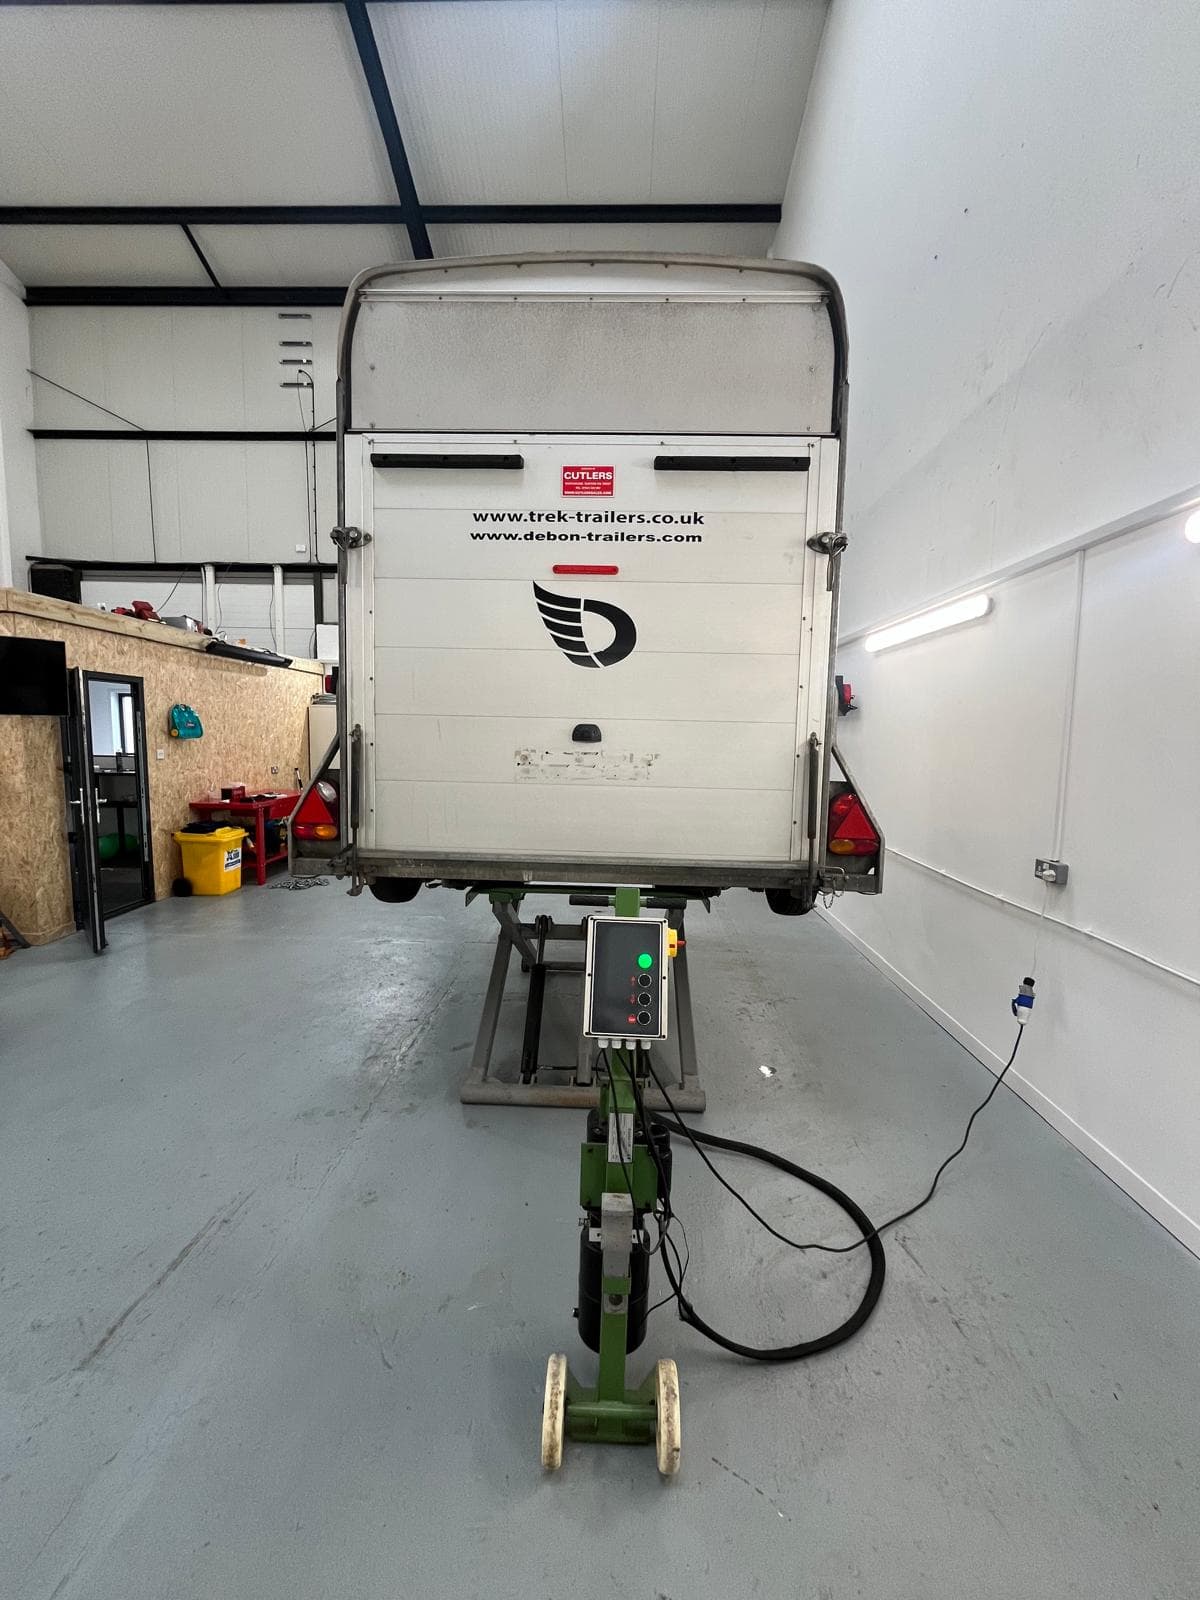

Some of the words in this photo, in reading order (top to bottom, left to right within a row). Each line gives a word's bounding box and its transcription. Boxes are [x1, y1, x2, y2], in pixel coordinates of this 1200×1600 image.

[563, 471, 613, 480] CUTLERS
[472, 510, 705, 525] www.trek-trailers.co.uk
[470, 531, 703, 543] www.debon-trailers.com
